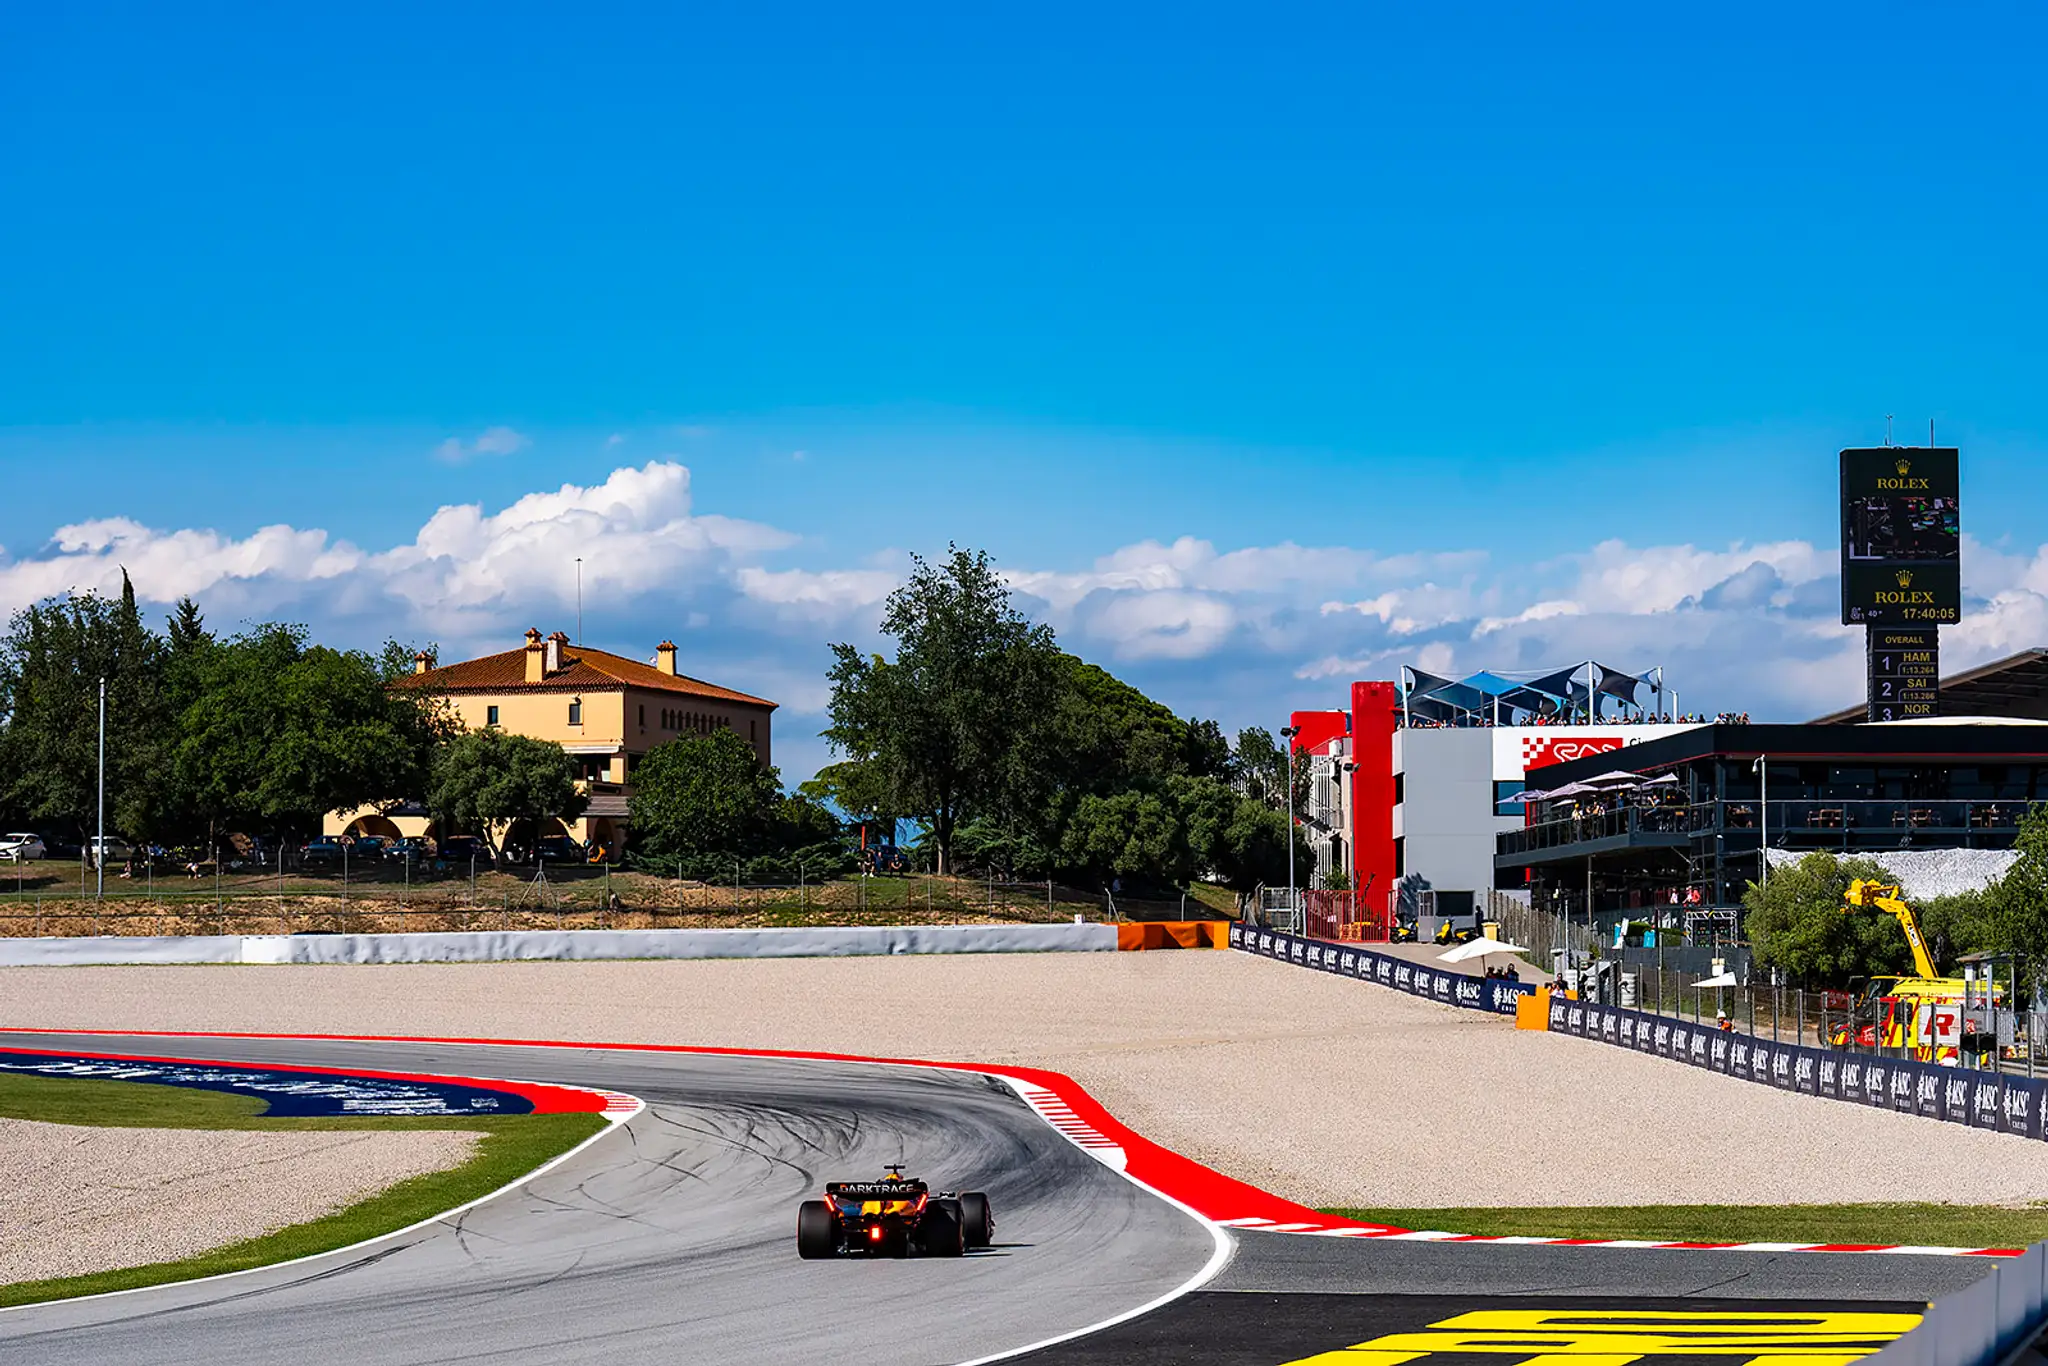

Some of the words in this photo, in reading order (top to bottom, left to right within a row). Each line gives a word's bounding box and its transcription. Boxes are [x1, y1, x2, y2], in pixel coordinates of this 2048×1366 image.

[1877, 478, 1929, 489] ROLEX
[1875, 591, 1935, 604] ROLEX
[1902, 608, 1955, 619] 17:40:05
[1885, 636, 1924, 644] OVERALL
[1882, 656, 1890, 671] 1
[1903, 652, 1930, 662] HAM
[1882, 682, 1892, 697] 2
[1907, 678, 1927, 688] SAI
[1882, 707, 1892, 722] 3
[1904, 704, 1931, 714] NOR
[839, 1184, 914, 1193] DARKTRACE
